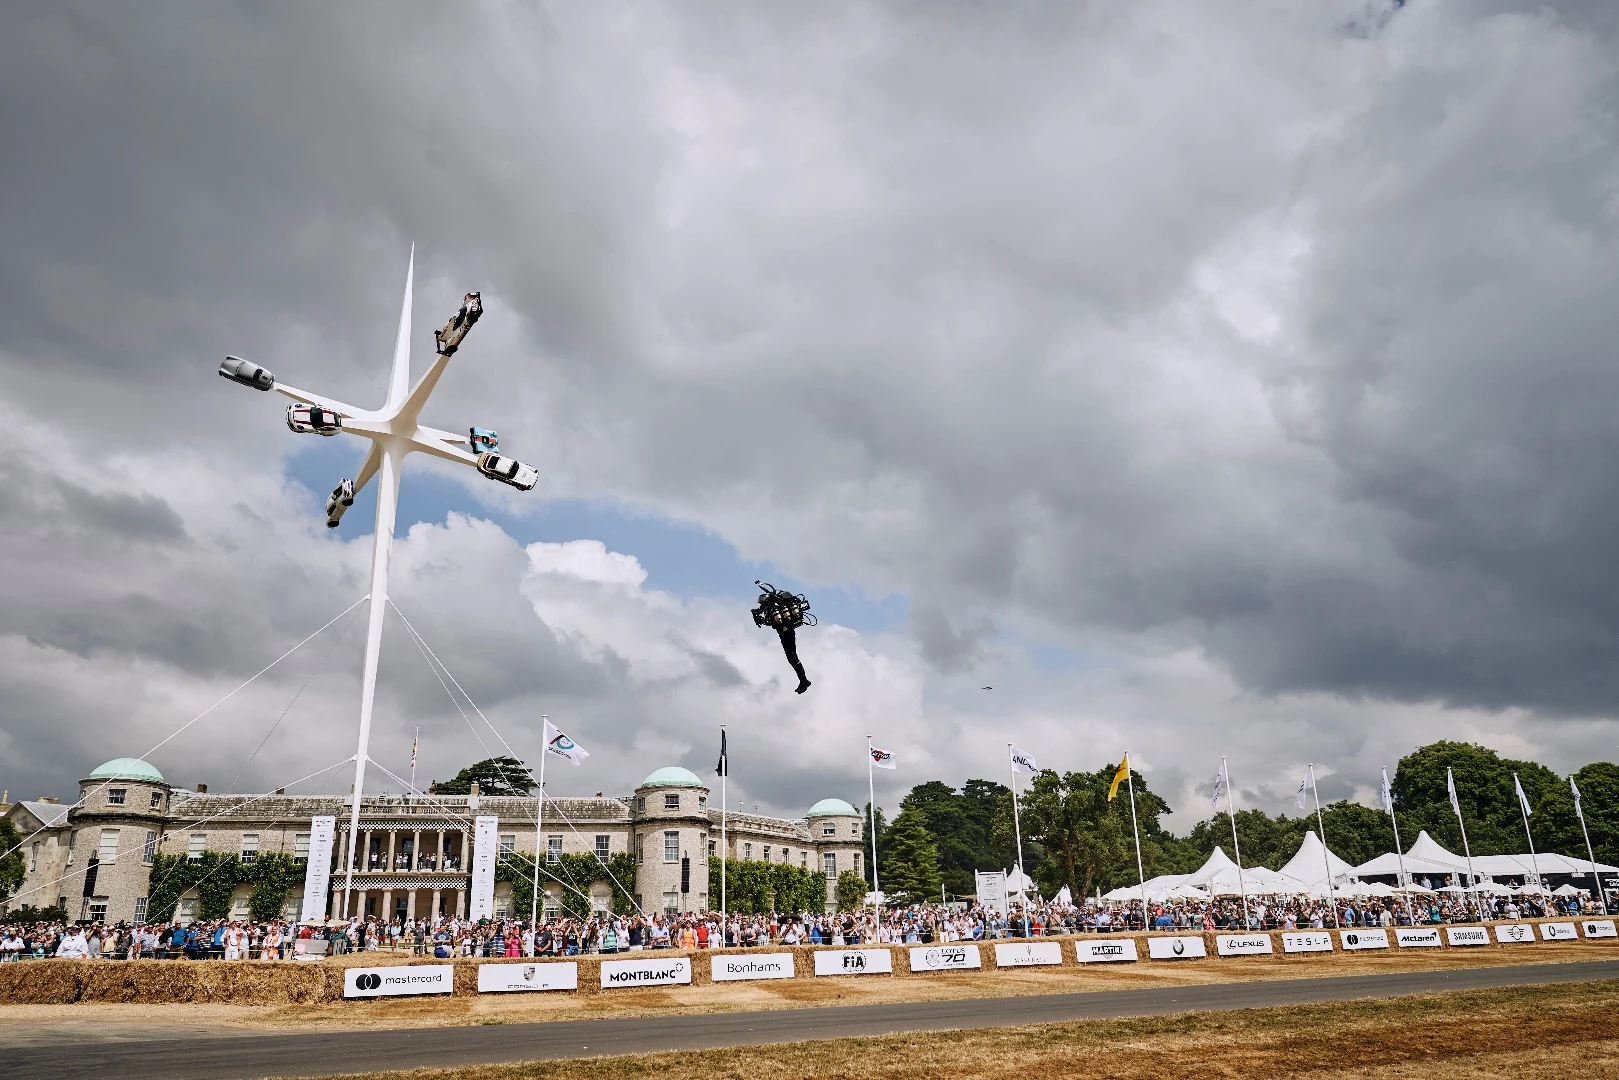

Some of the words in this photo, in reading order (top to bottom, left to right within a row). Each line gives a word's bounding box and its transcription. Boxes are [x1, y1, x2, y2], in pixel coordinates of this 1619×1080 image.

[1453, 931, 1484, 941] SAMSUNG
[1092, 946, 1123, 955] MARTINI
[941, 953, 966, 963] 70
[727, 961, 781, 973] Bonhams
[385, 973, 442, 984] mastercard
[609, 969, 676, 982] MONTBLANC
